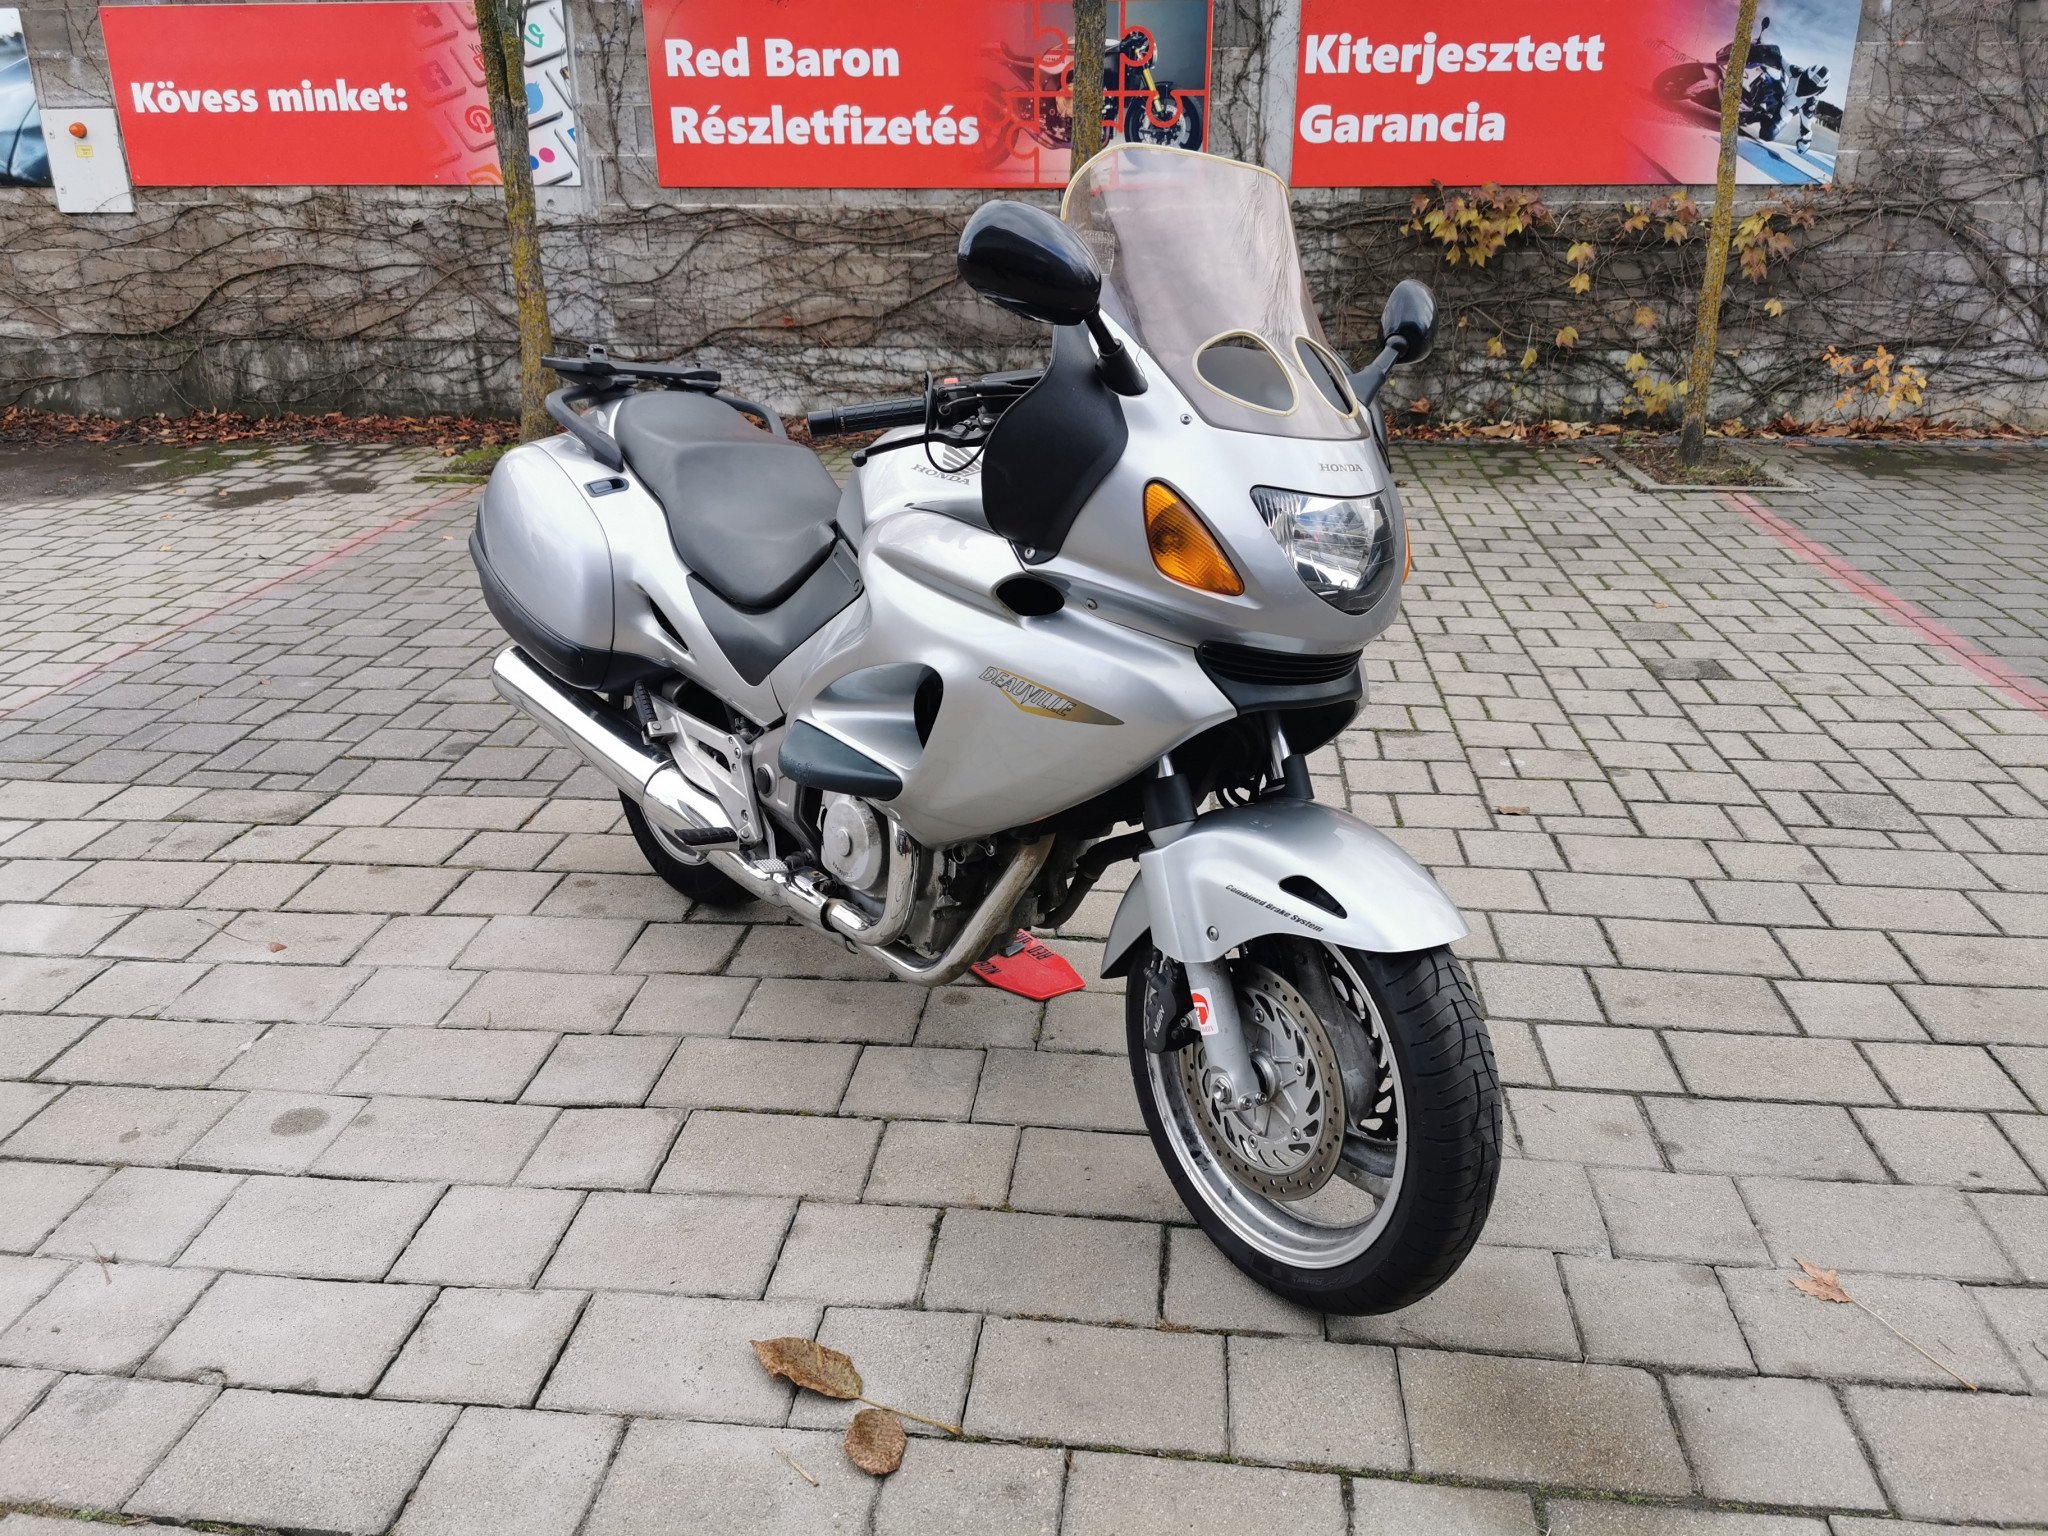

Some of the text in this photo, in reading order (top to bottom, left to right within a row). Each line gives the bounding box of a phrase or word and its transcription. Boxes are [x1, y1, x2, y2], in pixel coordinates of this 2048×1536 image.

[665, 37, 900, 78] Red Baron
[1304, 32, 1605, 84] Kiterjesztett
[130, 79, 409, 114] Kövess minket:
[670, 103, 980, 146] Részletfizetés
[1299, 101, 1507, 144] Garancia
[911, 464, 971, 486] HONDA
[1320, 463, 1364, 472] HONDA
[978, 665, 1078, 717] DEAUVILLE
[1225, 884, 1324, 932] Combined Brake System
